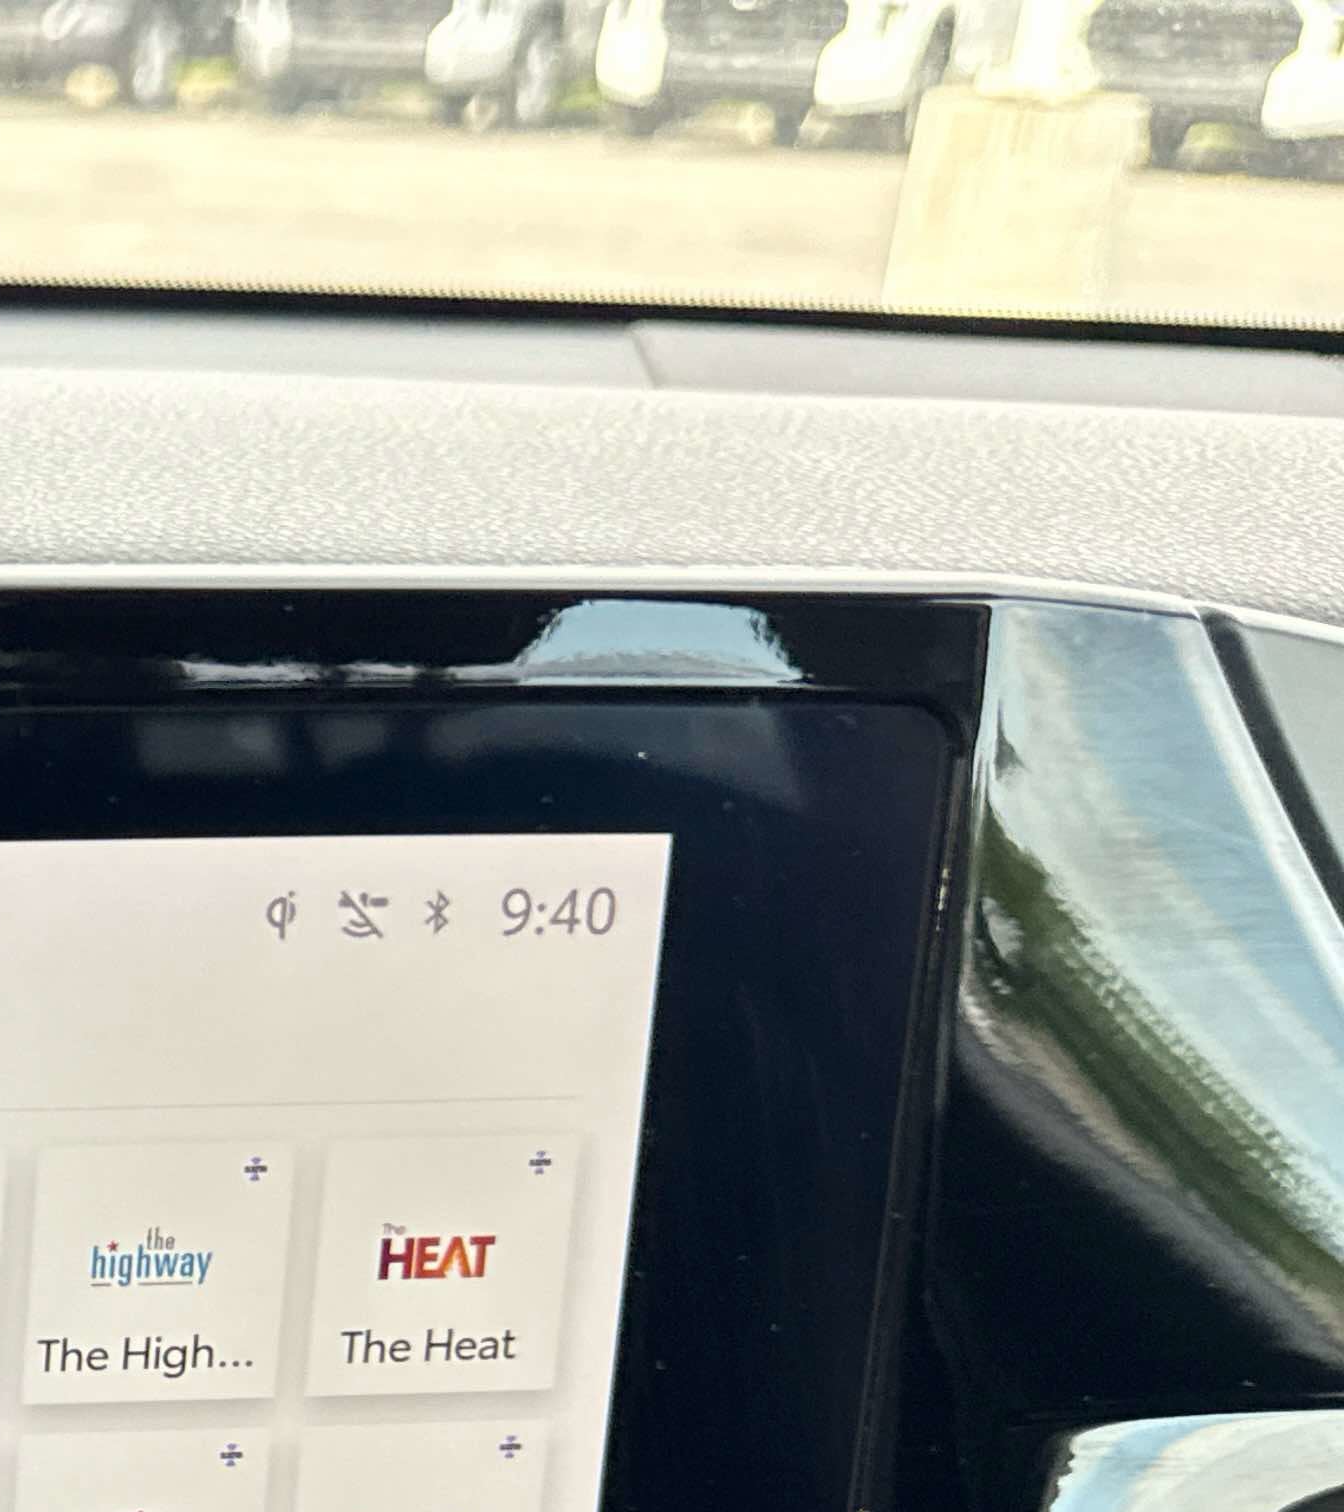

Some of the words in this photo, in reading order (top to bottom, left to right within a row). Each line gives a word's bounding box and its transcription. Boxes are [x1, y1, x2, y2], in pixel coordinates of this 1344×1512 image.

[502, 887, 616, 936] 9:40
[147, 1227, 175, 1250] the
[378, 1236, 496, 1280] HEAT
[92, 1240, 212, 1286] highway
[38, 1338, 108, 1372] The
[341, 1330, 411, 1363] The
[425, 1329, 515, 1361] Heat
